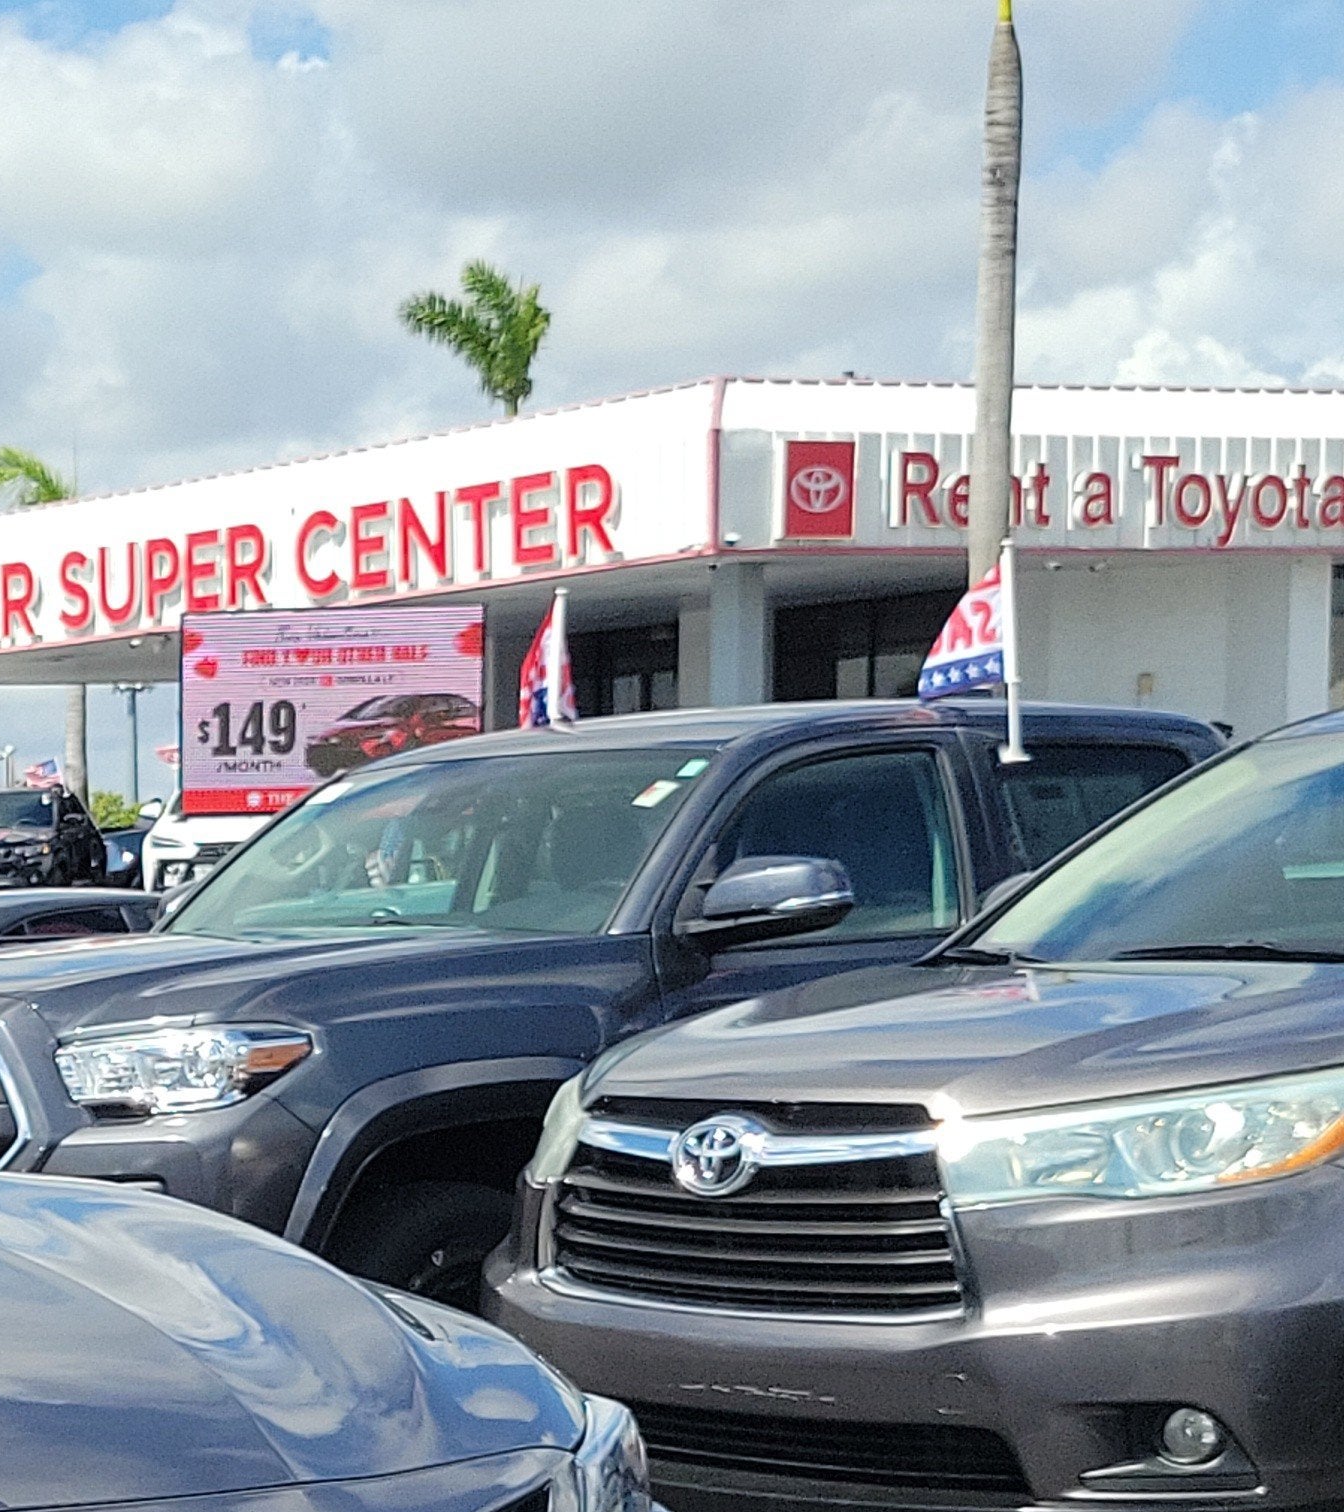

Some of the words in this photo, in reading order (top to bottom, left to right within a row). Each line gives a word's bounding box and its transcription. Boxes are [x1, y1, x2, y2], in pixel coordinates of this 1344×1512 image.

[59, 523, 268, 631] SUPER
[294, 463, 616, 597] CENTER
[1081, 471, 1114, 527] a
[1141, 455, 1344, 547] Toyota
[198, 699, 297, 758] $149
